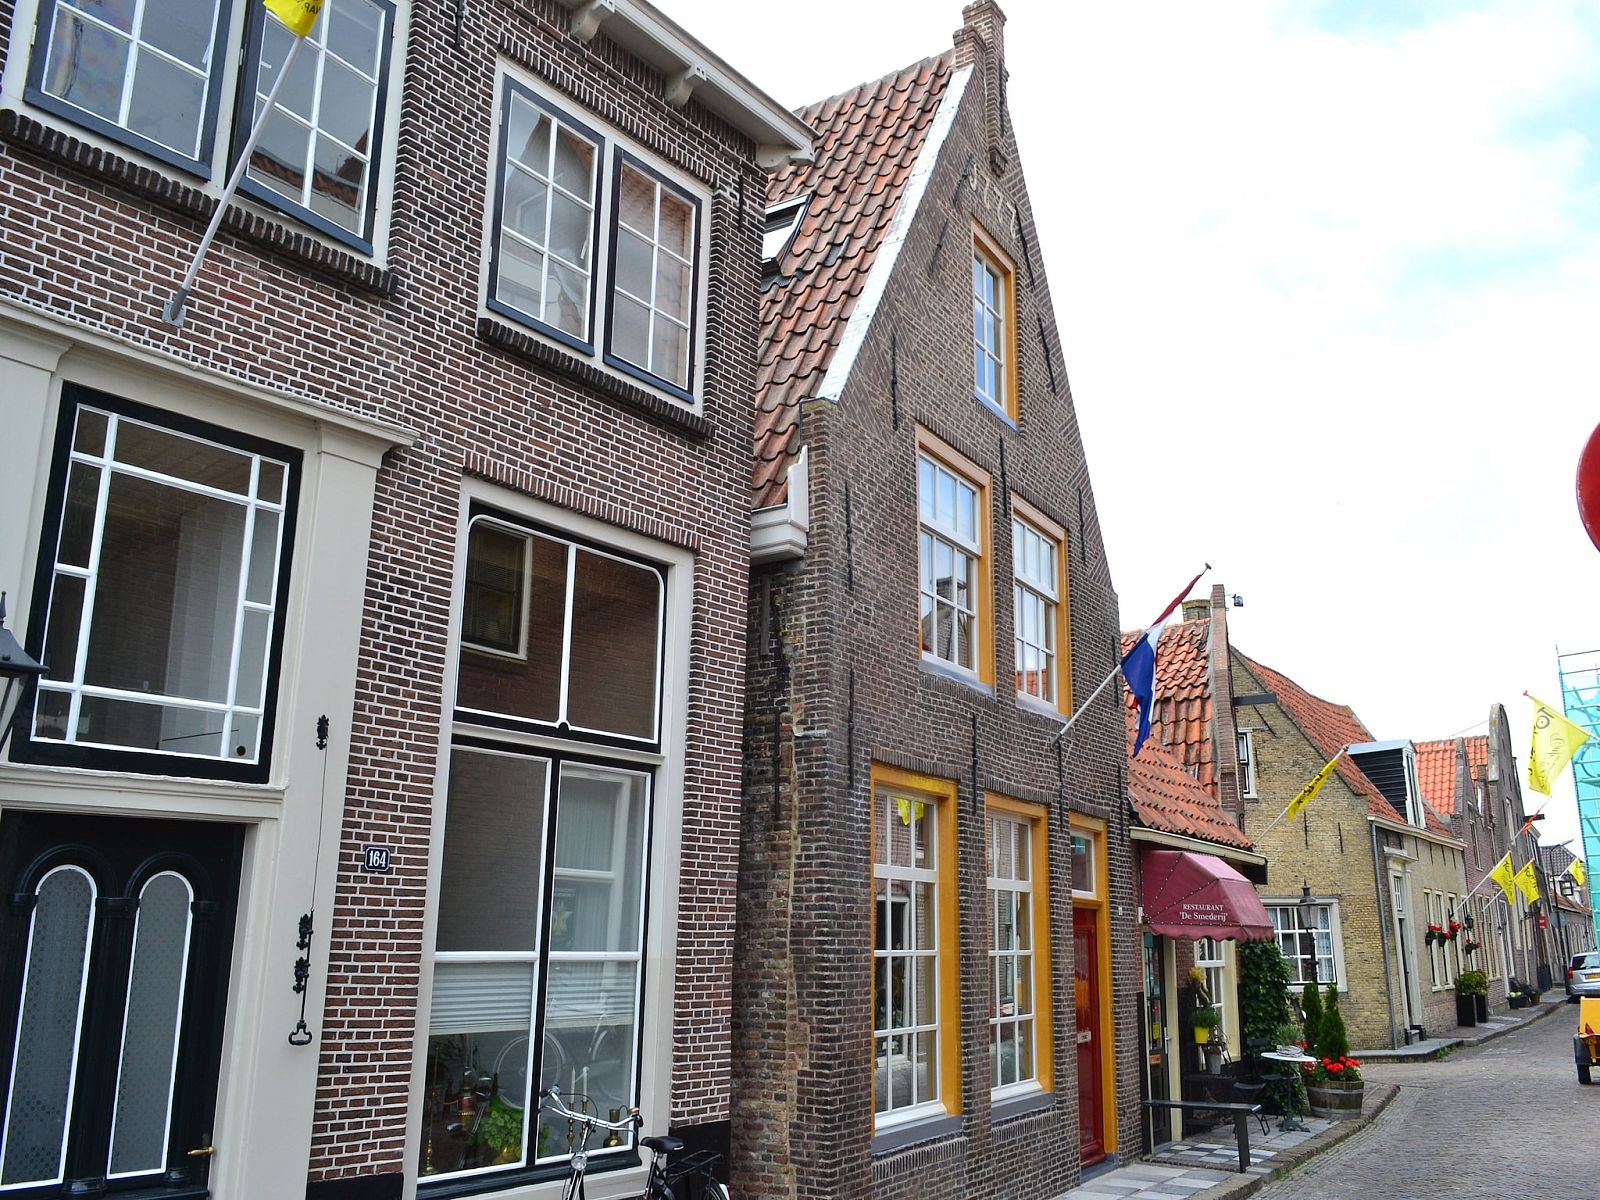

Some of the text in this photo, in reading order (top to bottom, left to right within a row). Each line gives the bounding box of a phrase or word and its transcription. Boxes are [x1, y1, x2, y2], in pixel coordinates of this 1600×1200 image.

[368, 850, 387, 868] 164
[1182, 903, 1224, 911] RESTAURANT
[1179, 911, 1228, 922] 'De Smederij'
